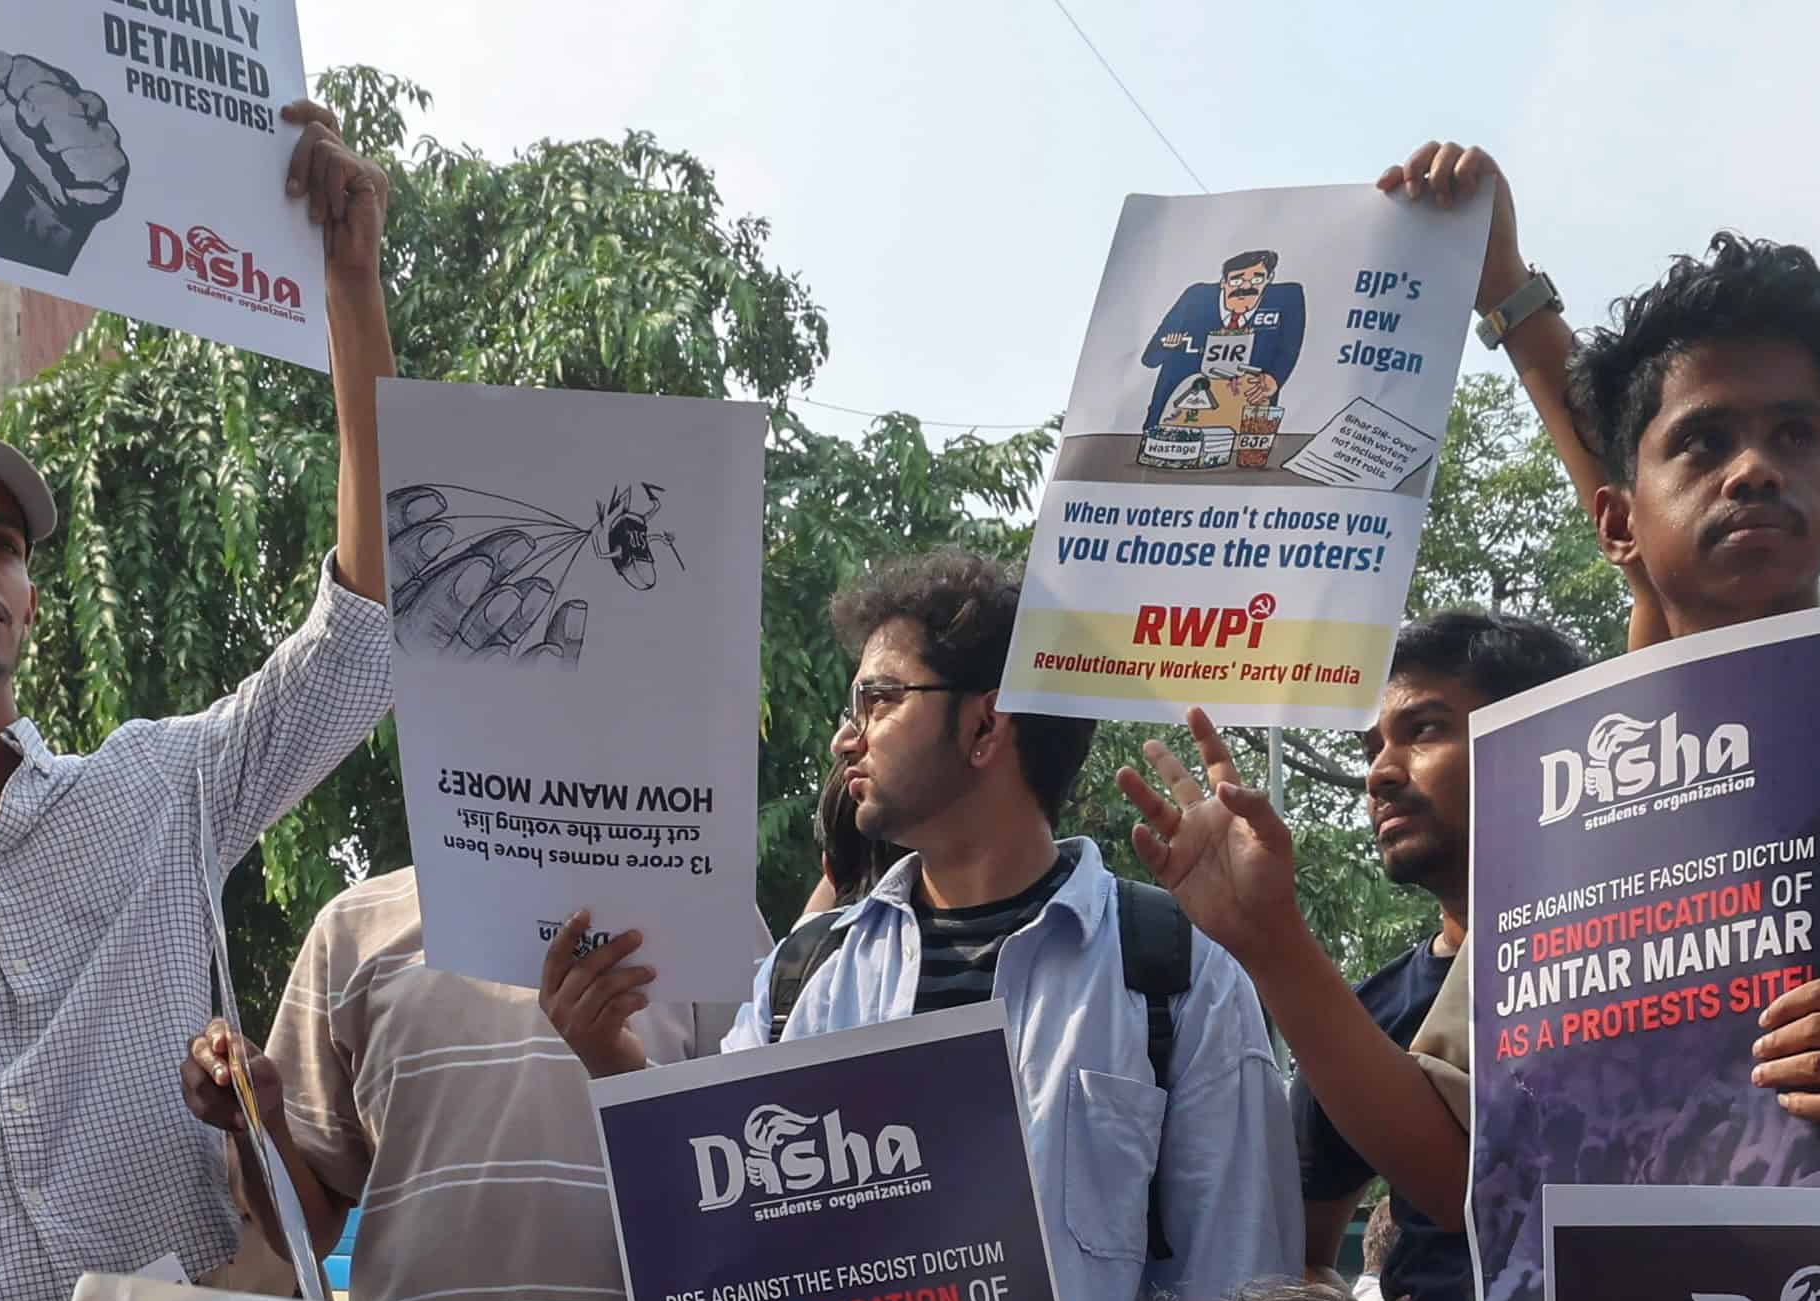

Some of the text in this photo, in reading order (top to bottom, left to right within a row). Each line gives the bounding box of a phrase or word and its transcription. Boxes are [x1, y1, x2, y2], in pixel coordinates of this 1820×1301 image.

[103, 12, 270, 98] DETAINED
[126, 67, 275, 134] PROTESTORS!
[146, 221, 301, 308] Disha
[1354, 270, 1422, 299] BJP's
[1253, 312, 1279, 326] ECI
[1347, 308, 1401, 333] new
[1206, 343, 1247, 362] SIR
[1337, 340, 1423, 374] slogan
[1344, 414, 1372, 431] Bihar
[1240, 435, 1270, 450] BJP
[1331, 436, 1405, 475] not included in
[1333, 450, 1362, 468] draft
[1339, 425, 1409, 463] 65 voters
[1064, 501, 1394, 540] When voters don't choose you,
[1058, 535, 1386, 573] you choose the voters!
[1033, 652, 1361, 685] Revolutionary Workers' Party Of India
[1538, 711, 1750, 827] Disha
[437, 768, 714, 813] HOW MANY MORE?
[1653, 775, 1756, 812] organization
[456, 808, 701, 848] cut from the voting list,
[443, 834, 714, 875] 13 crore names have been
[1497, 836, 1815, 934] RISE AGAINST THE FASCIST DICTUM
[1496, 871, 1814, 973] OF DENOTIFICATION OF
[1496, 910, 1813, 1018] JANTAR MANTAR
[1496, 1023, 1530, 1062] AS
[1536, 1019, 1555, 1051] A
[1560, 983, 1722, 1047] PROTESTS
[689, 1103, 923, 1212] Disha
[828, 1178, 932, 1210] organization
[794, 1270, 833, 1295] THE
[836, 1255, 918, 1290] FASCIST
[923, 1241, 1005, 1275] DICTUM
